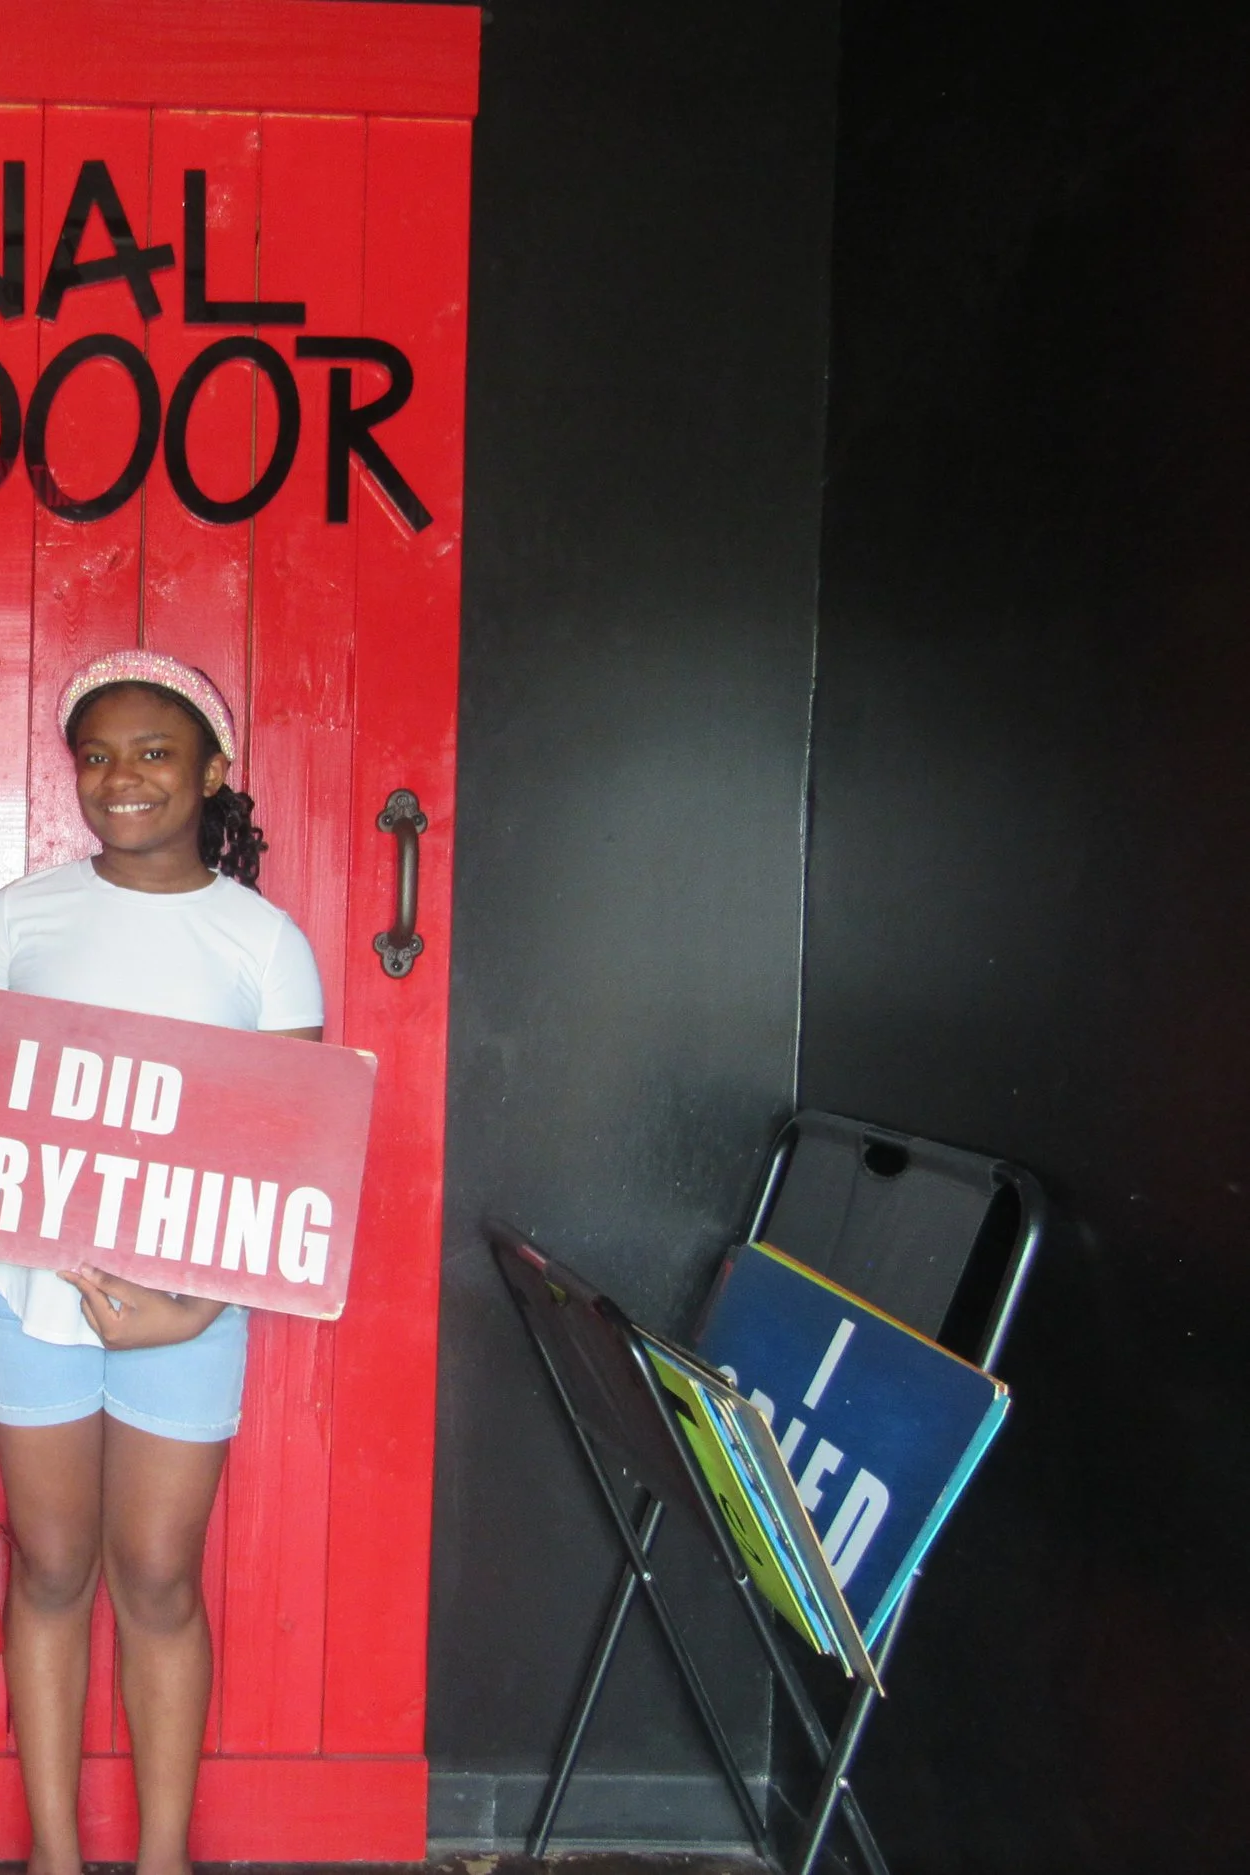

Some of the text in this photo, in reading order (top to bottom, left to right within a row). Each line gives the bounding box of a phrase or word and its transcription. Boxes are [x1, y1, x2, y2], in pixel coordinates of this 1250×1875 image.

[8, 1039, 183, 1135] I DID
[803, 1318, 855, 1410] I
